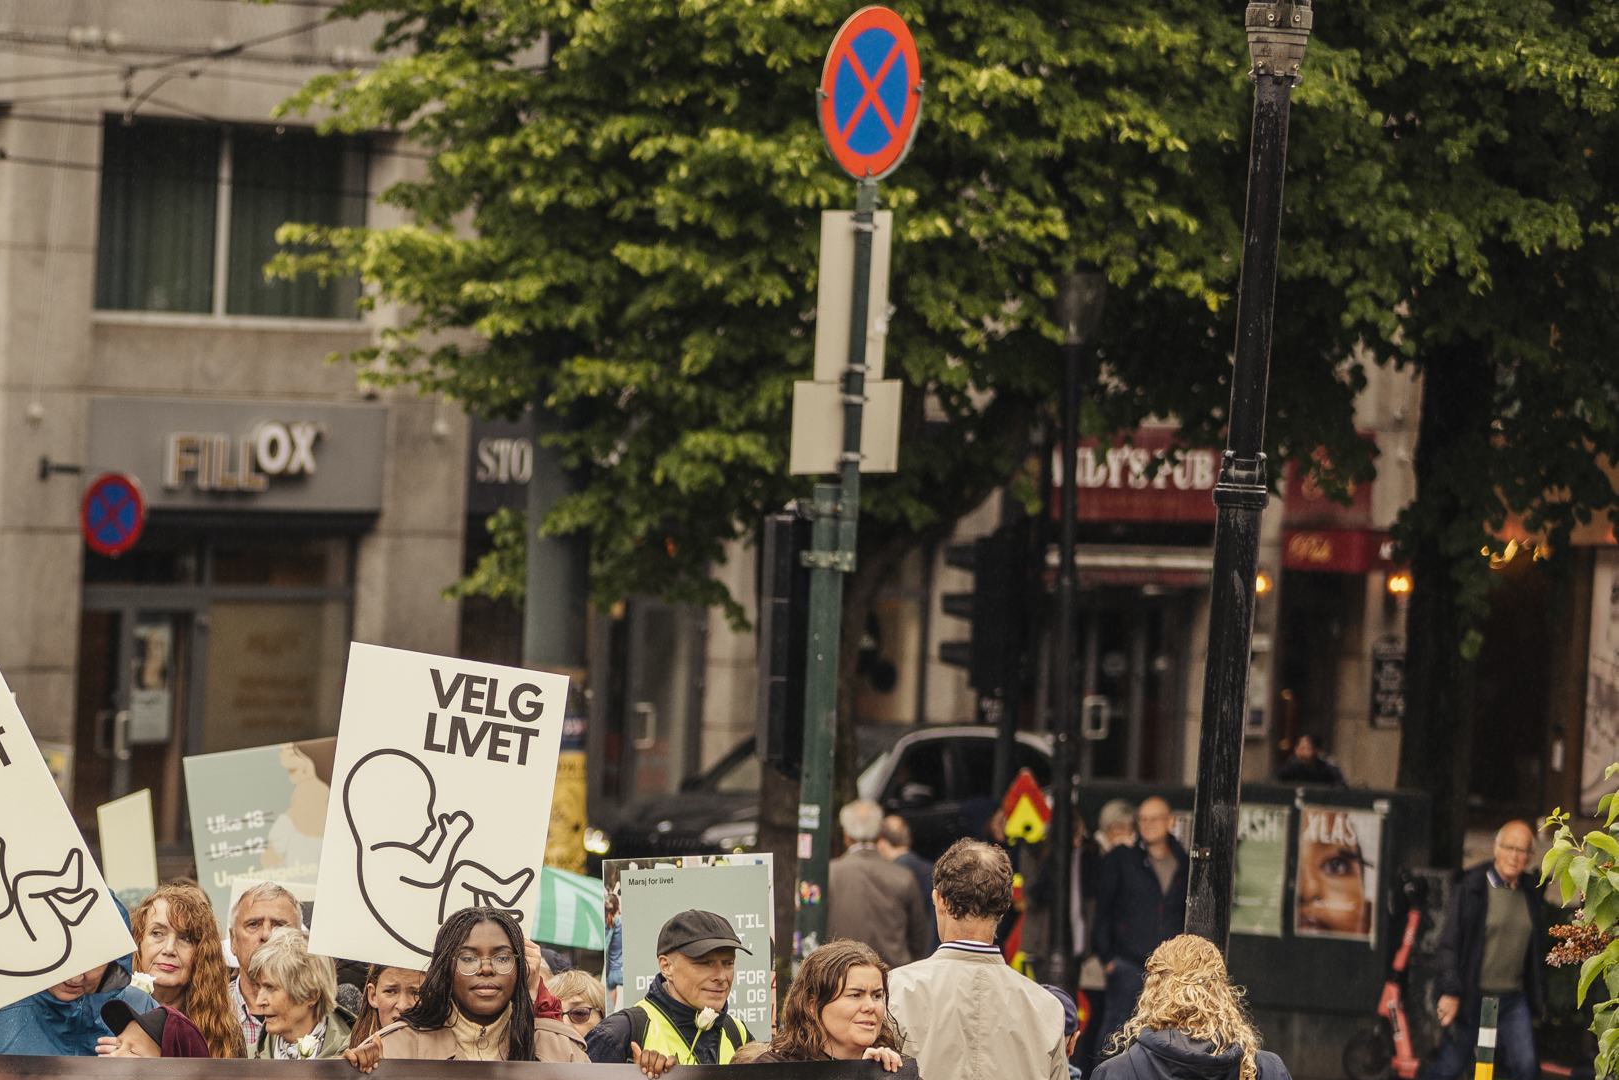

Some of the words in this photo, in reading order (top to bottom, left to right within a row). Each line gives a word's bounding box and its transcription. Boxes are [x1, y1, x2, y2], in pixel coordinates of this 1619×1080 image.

[429, 668, 544, 723] VELG
[424, 712, 540, 766] LIVET
[628, 877, 647, 887] Marsj
[648, 877, 658, 885] for
[659, 876, 674, 884] livet
[735, 914, 764, 929] TIL
[737, 970, 766, 985] FOR
[746, 988, 767, 1004] OG
